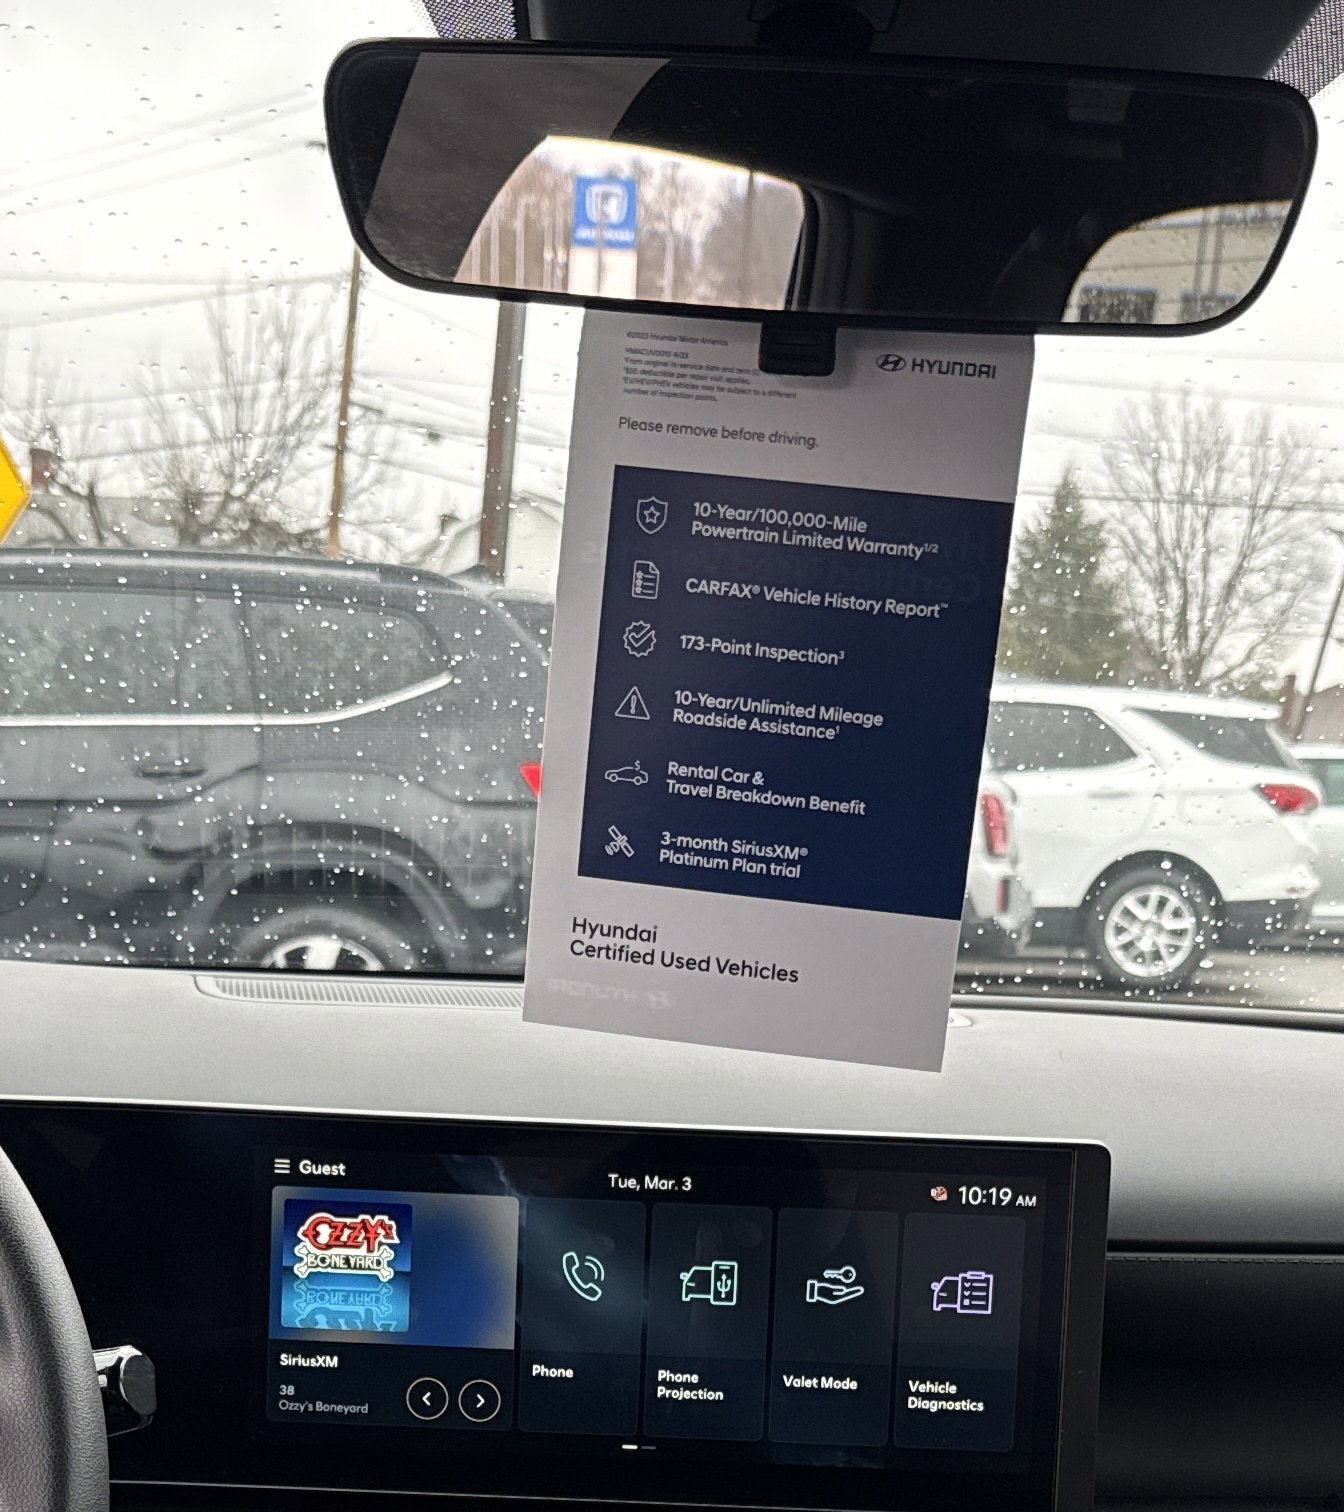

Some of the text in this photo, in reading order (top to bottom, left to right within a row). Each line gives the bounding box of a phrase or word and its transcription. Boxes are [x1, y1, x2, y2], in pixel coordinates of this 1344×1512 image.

[912, 358, 997, 380] HYUNDAI
[618, 416, 818, 448] Please remove before driving.
[693, 502, 868, 532] 10-Year/100,000-Mile
[691, 522, 778, 544] Powertrain
[782, 530, 843, 550] Limited
[763, 586, 821, 606] Vehicle
[824, 593, 881, 615] History
[680, 634, 752, 656] 173-Point
[672, 708, 746, 730] Roadside
[674, 690, 884, 728] 10-Year/Unlimited Mileage
[667, 761, 764, 785] Rental Car &
[666, 779, 866, 816] Travel Breakdown Benefit
[660, 831, 728, 853] 3-month
[659, 849, 802, 878] Platinum Plan trial
[572, 917, 658, 943] Hyundai
[570, 940, 800, 983] Certified Used Vehicles
[298, 1160, 346, 1177] Guest
[608, 1174, 692, 1192] Tue, Mar. 3
[957, 1186, 1038, 1208] 10:19 AM
[307, 1254, 384, 1270] BONEYARD
[280, 1353, 338, 1368] SiriusXM
[532, 1364, 574, 1378] Phone
[657, 1370, 699, 1384] Phone
[782, 1374, 858, 1390] Valet Mode
[908, 1380, 958, 1394] Vehicle
[279, 1384, 295, 1396] 38
[656, 1386, 724, 1402] Projection
[278, 1400, 369, 1415] Ozzy's Boneyard
[907, 1397, 984, 1413] Diagnostics
